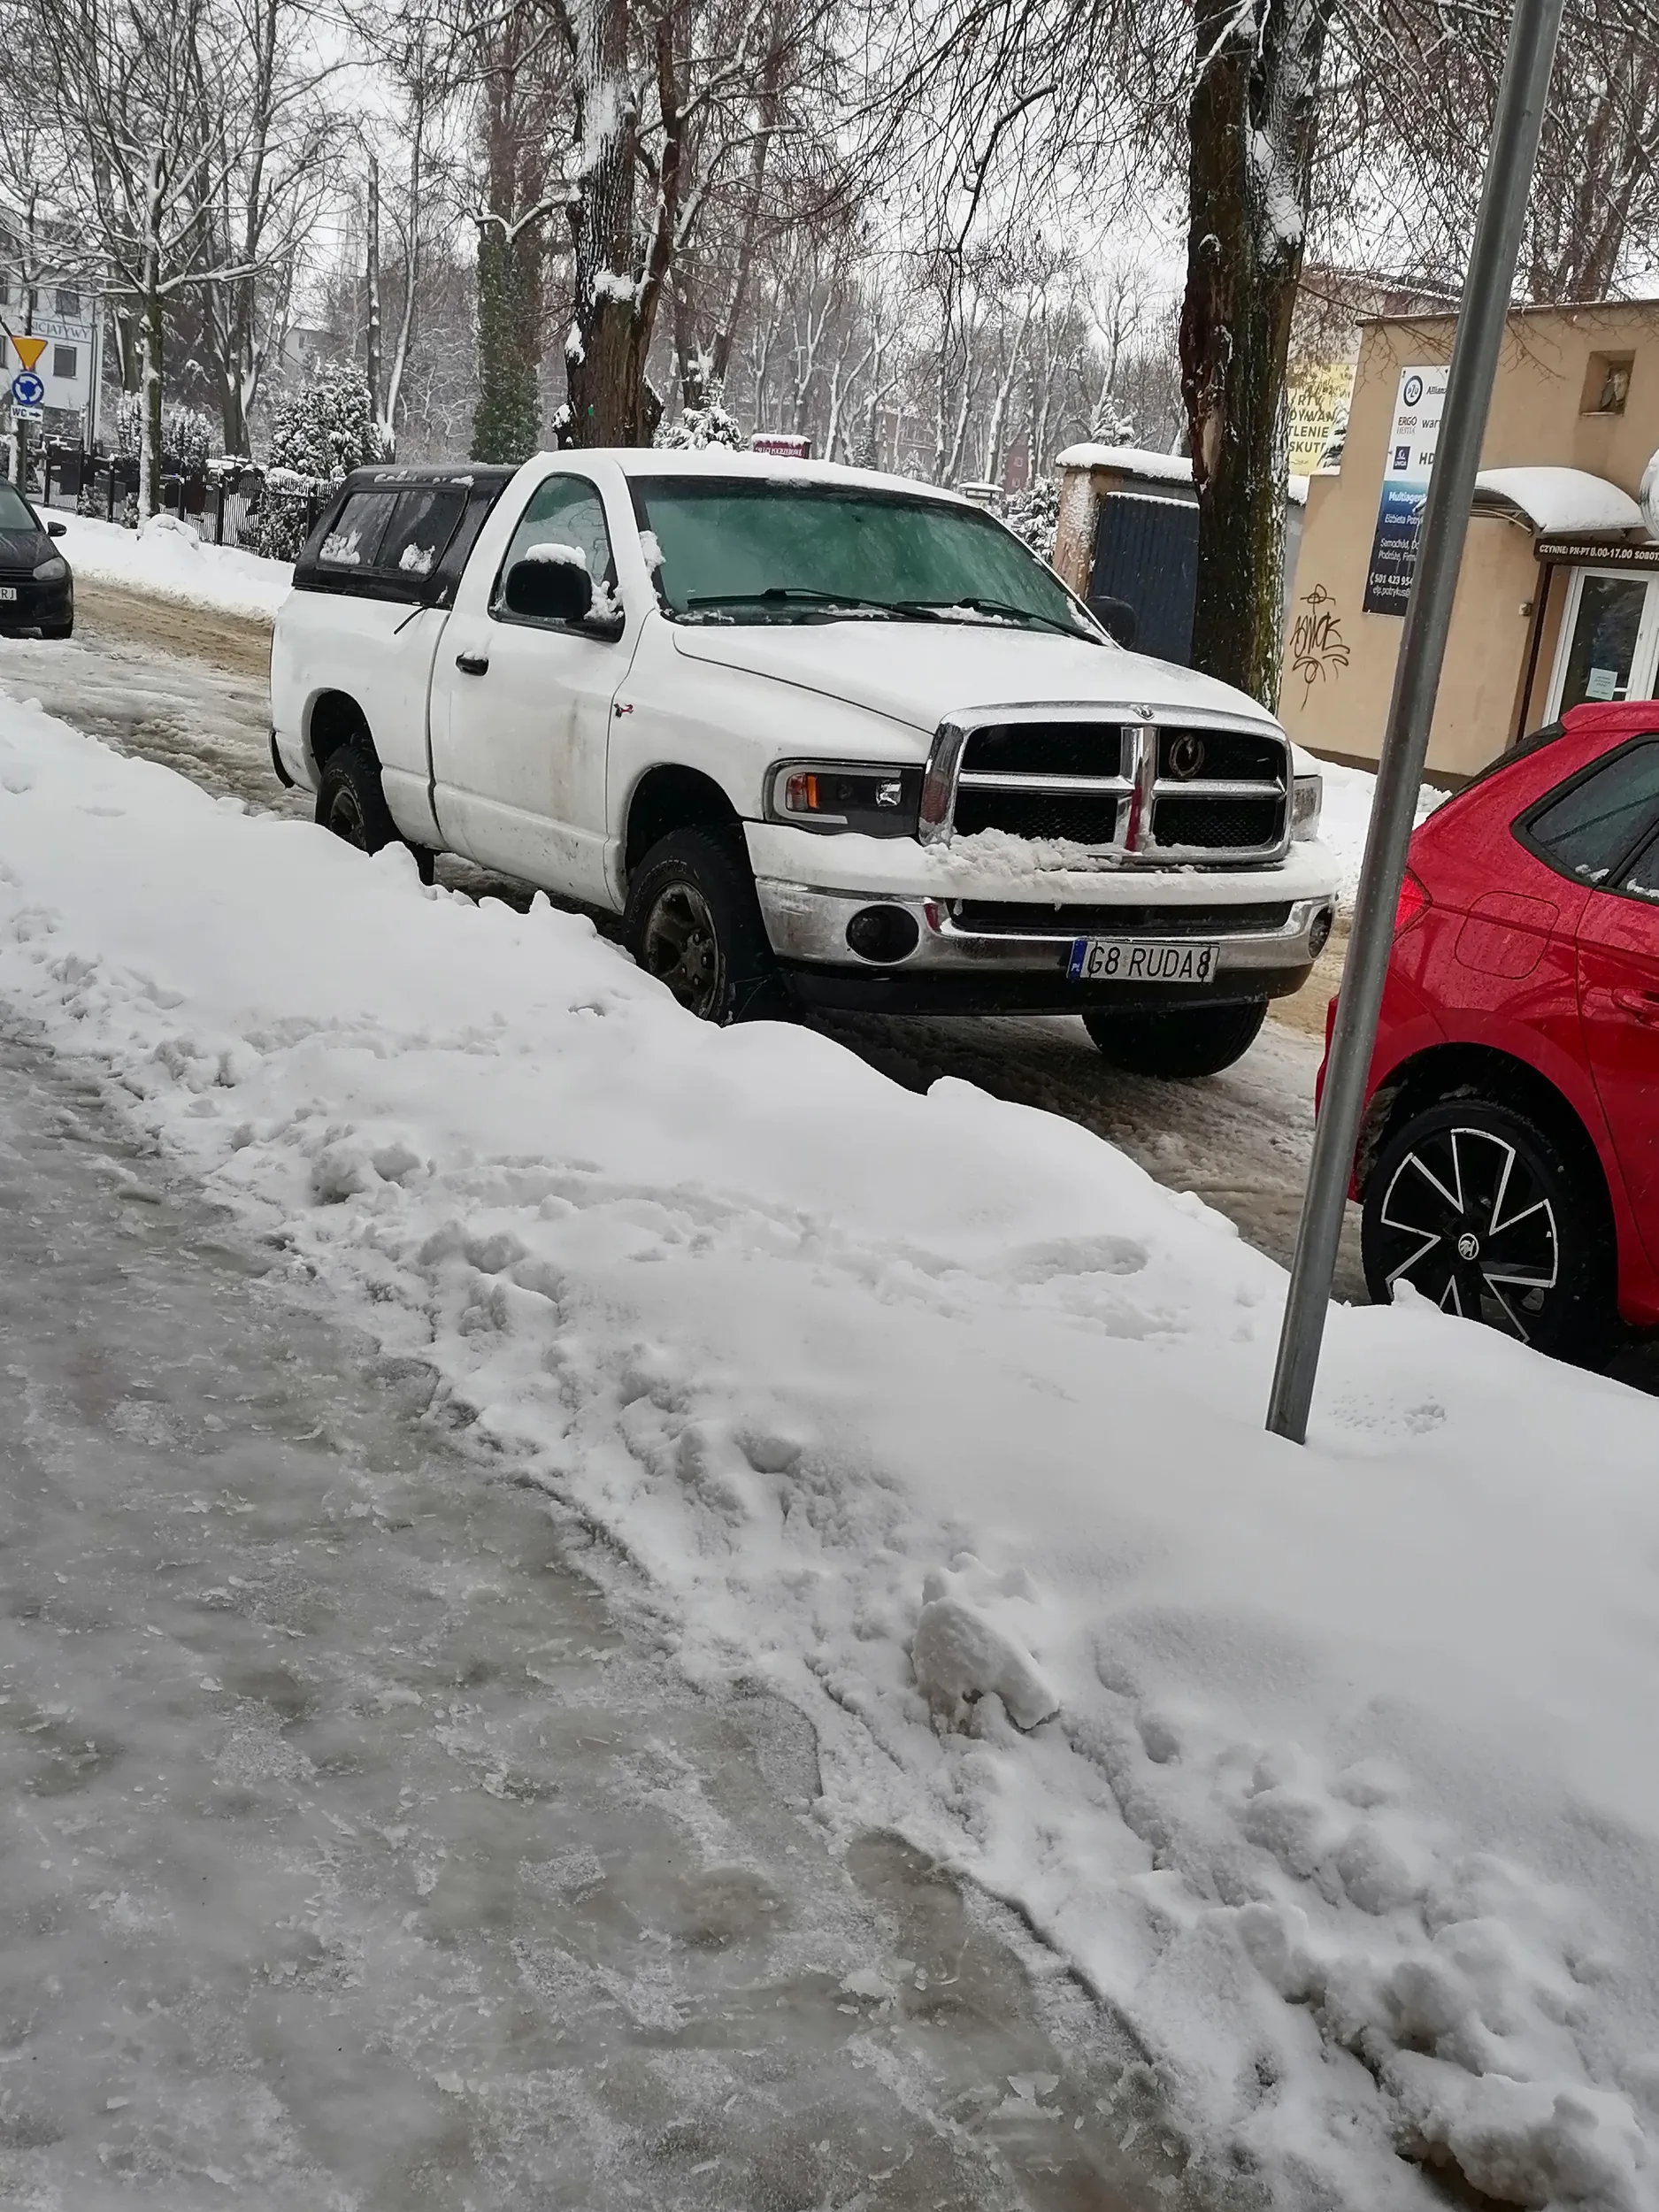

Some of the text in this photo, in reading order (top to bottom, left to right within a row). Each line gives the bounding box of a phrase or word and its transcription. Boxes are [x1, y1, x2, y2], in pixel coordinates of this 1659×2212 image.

[12, 407, 27, 418] WC
[1398, 416, 1417, 426] ERGO
[1087, 945, 1211, 978] G8 RUDA8
